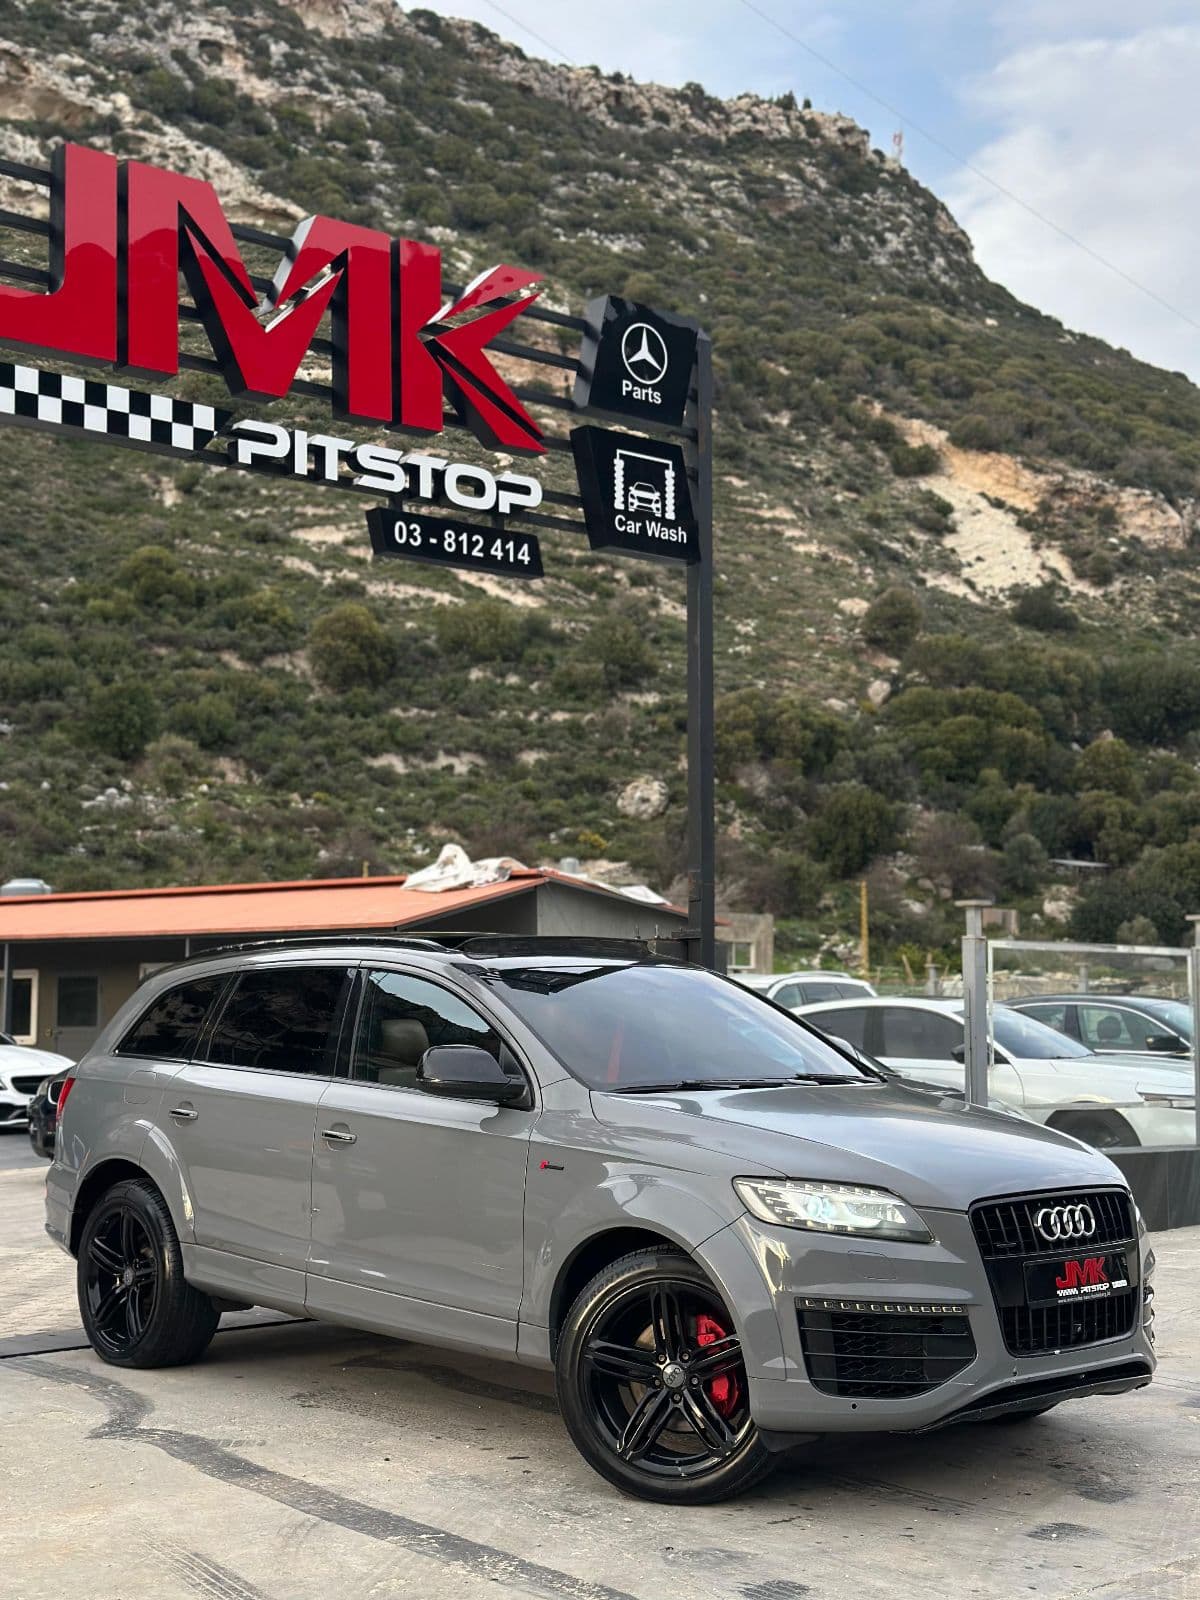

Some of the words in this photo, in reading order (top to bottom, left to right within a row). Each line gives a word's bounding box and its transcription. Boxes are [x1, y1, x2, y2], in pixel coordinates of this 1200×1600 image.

[0, 143, 547, 454] JMK
[622, 380, 662, 405] Parts
[231, 419, 543, 513] PITSTOP
[394, 520, 421, 546] 03
[443, 530, 484, 558] 812
[490, 538, 530, 565] 414
[614, 514, 642, 536] Car
[646, 519, 687, 544] Wash
[1056, 1258, 1107, 1287] JMK
[1081, 1282, 1109, 1293] PITSTOP
